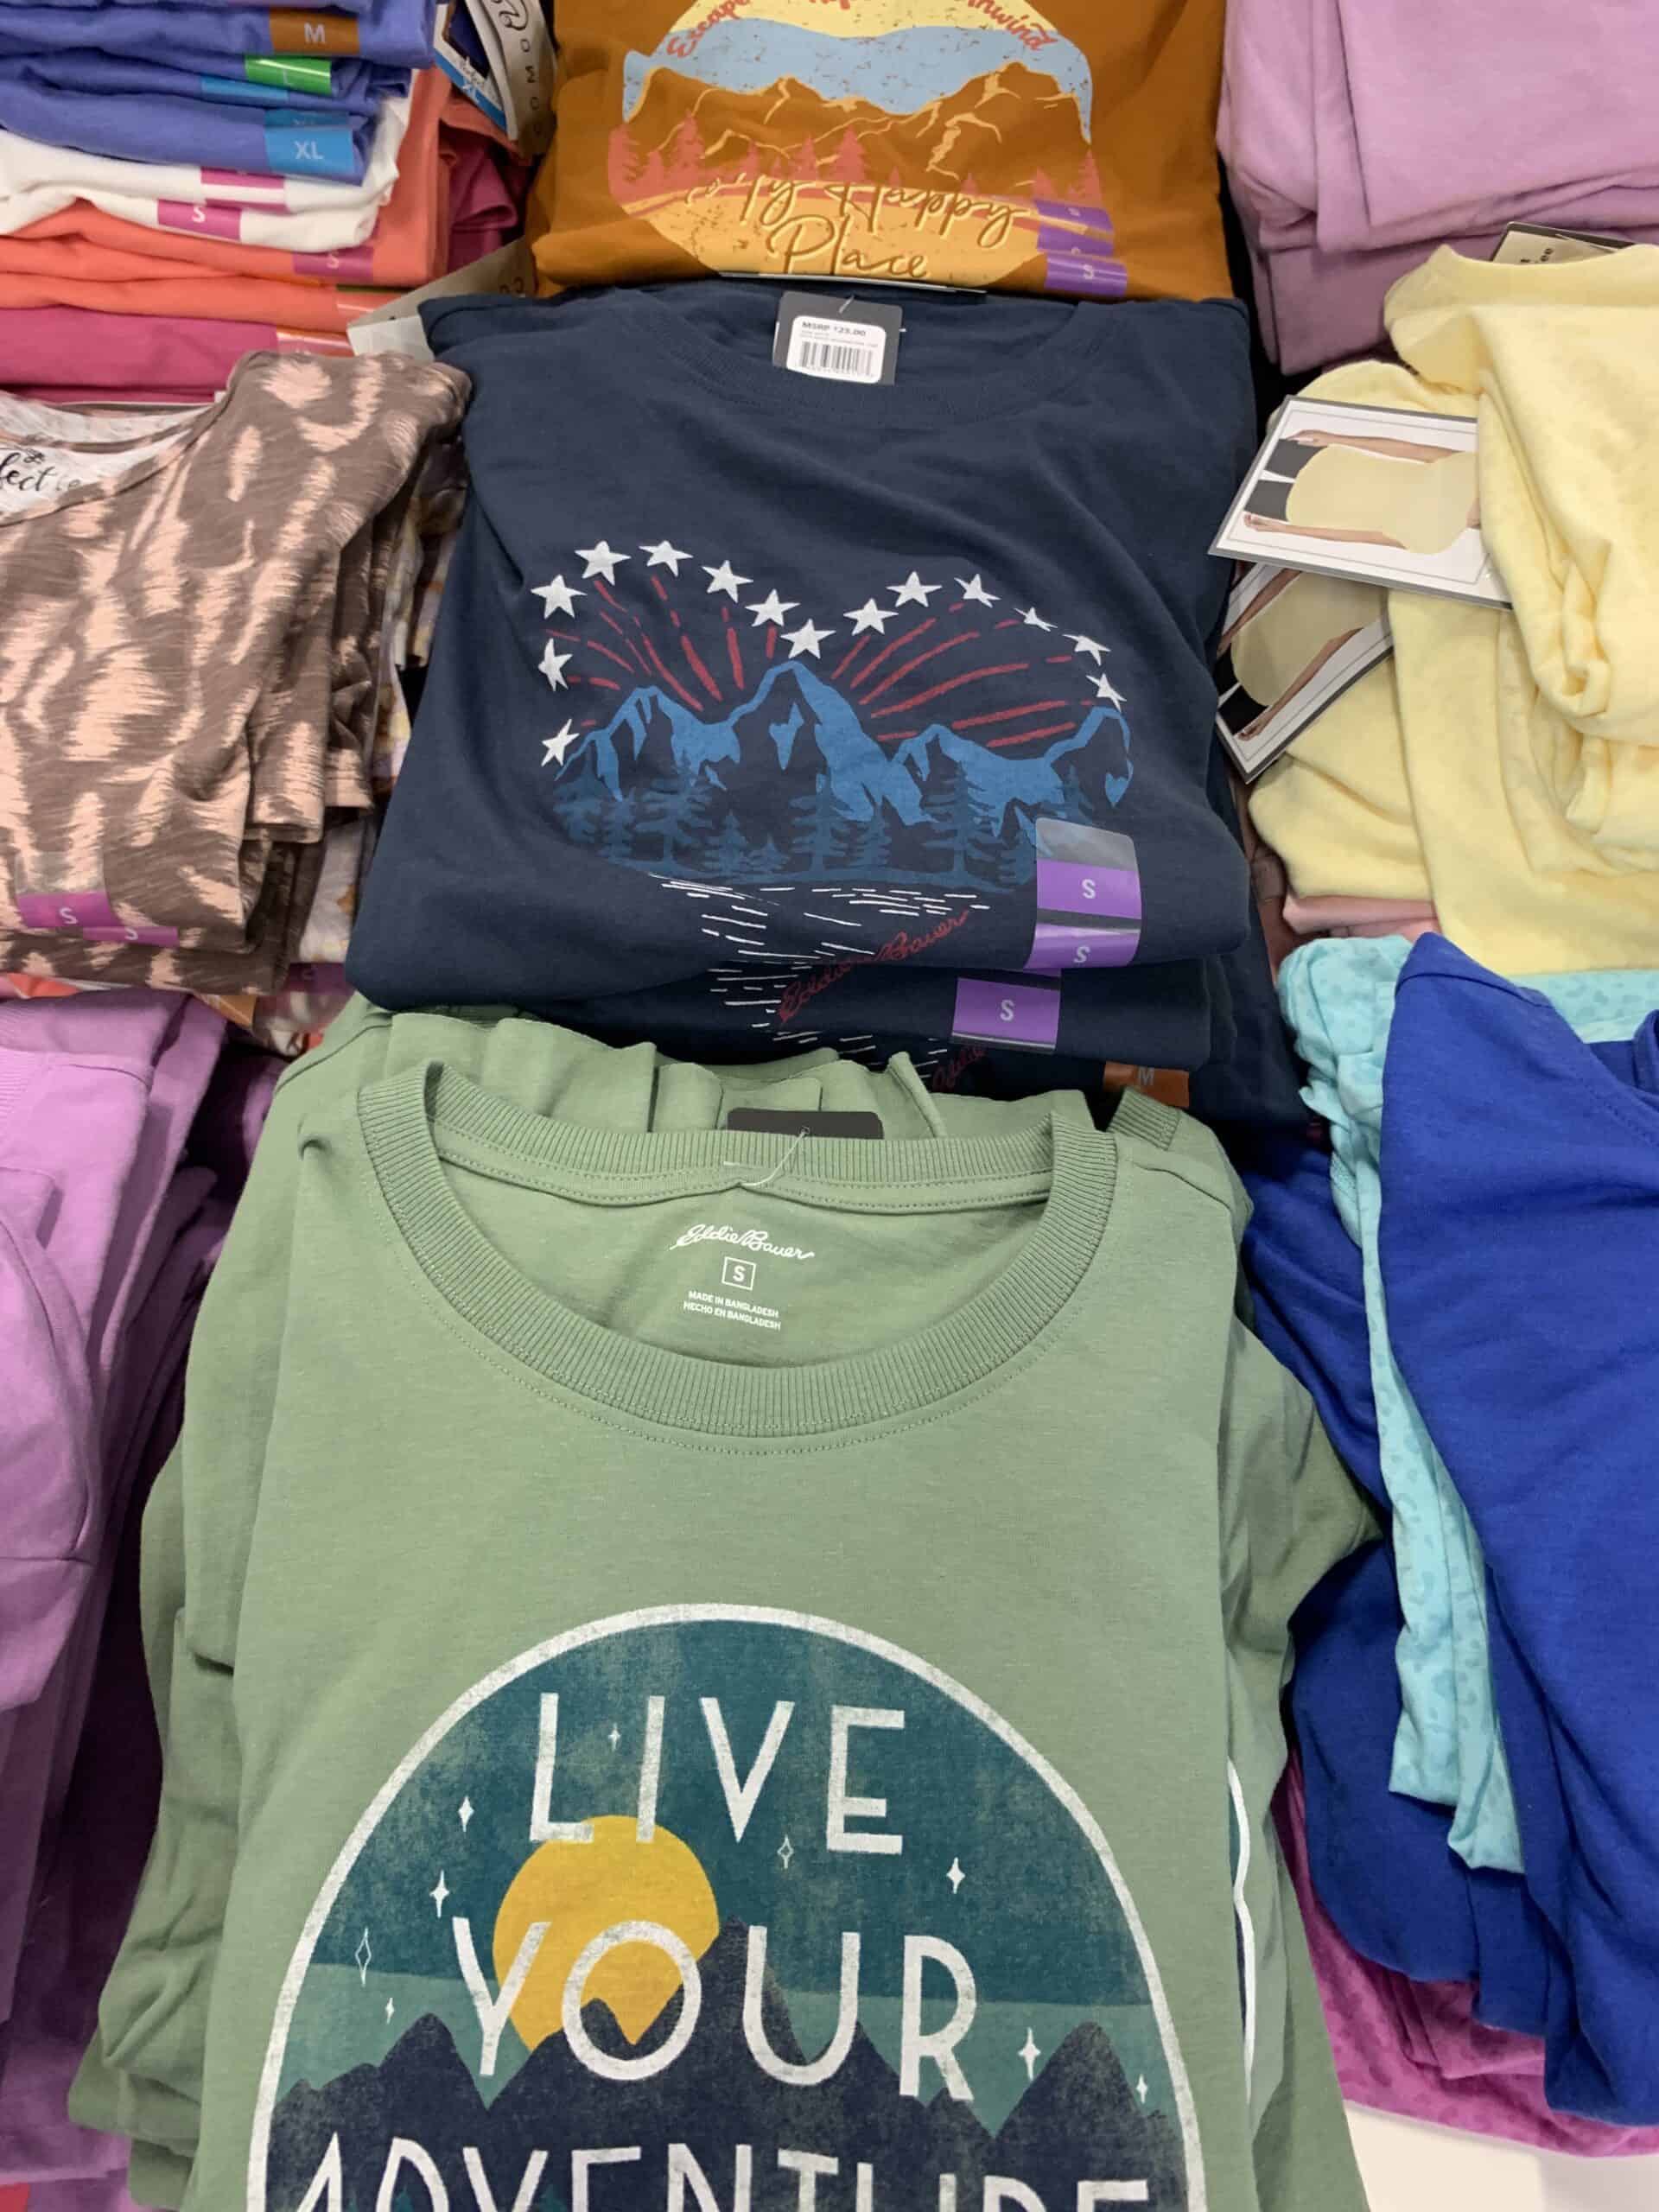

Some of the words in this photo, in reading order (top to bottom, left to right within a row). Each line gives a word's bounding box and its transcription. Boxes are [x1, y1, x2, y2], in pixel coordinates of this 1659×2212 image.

[303, 22, 327, 43] M
[294, 140, 325, 160] XL
[192, 205, 207, 223] S
[766, 213, 931, 277] Place
[1081, 878, 1096, 899] S
[60, 907, 79, 925] S
[1073, 945, 1091, 963] S
[999, 999, 1015, 1022] S
[1138, 1065, 1155, 1086] M
[732, 1265, 746, 1281] S
[688, 1290, 714, 1303] MADE
[715, 1295, 724, 1306] IN
[724, 1297, 779, 1319] BANGLADESH
[683, 1300, 713, 1314] HECHO
[714, 1306, 726, 1319] EN
[726, 1309, 781, 1331] BANGLADESH
[529, 1692, 906, 1855] LIVE
[451, 1916, 978, 2101] YOUR
